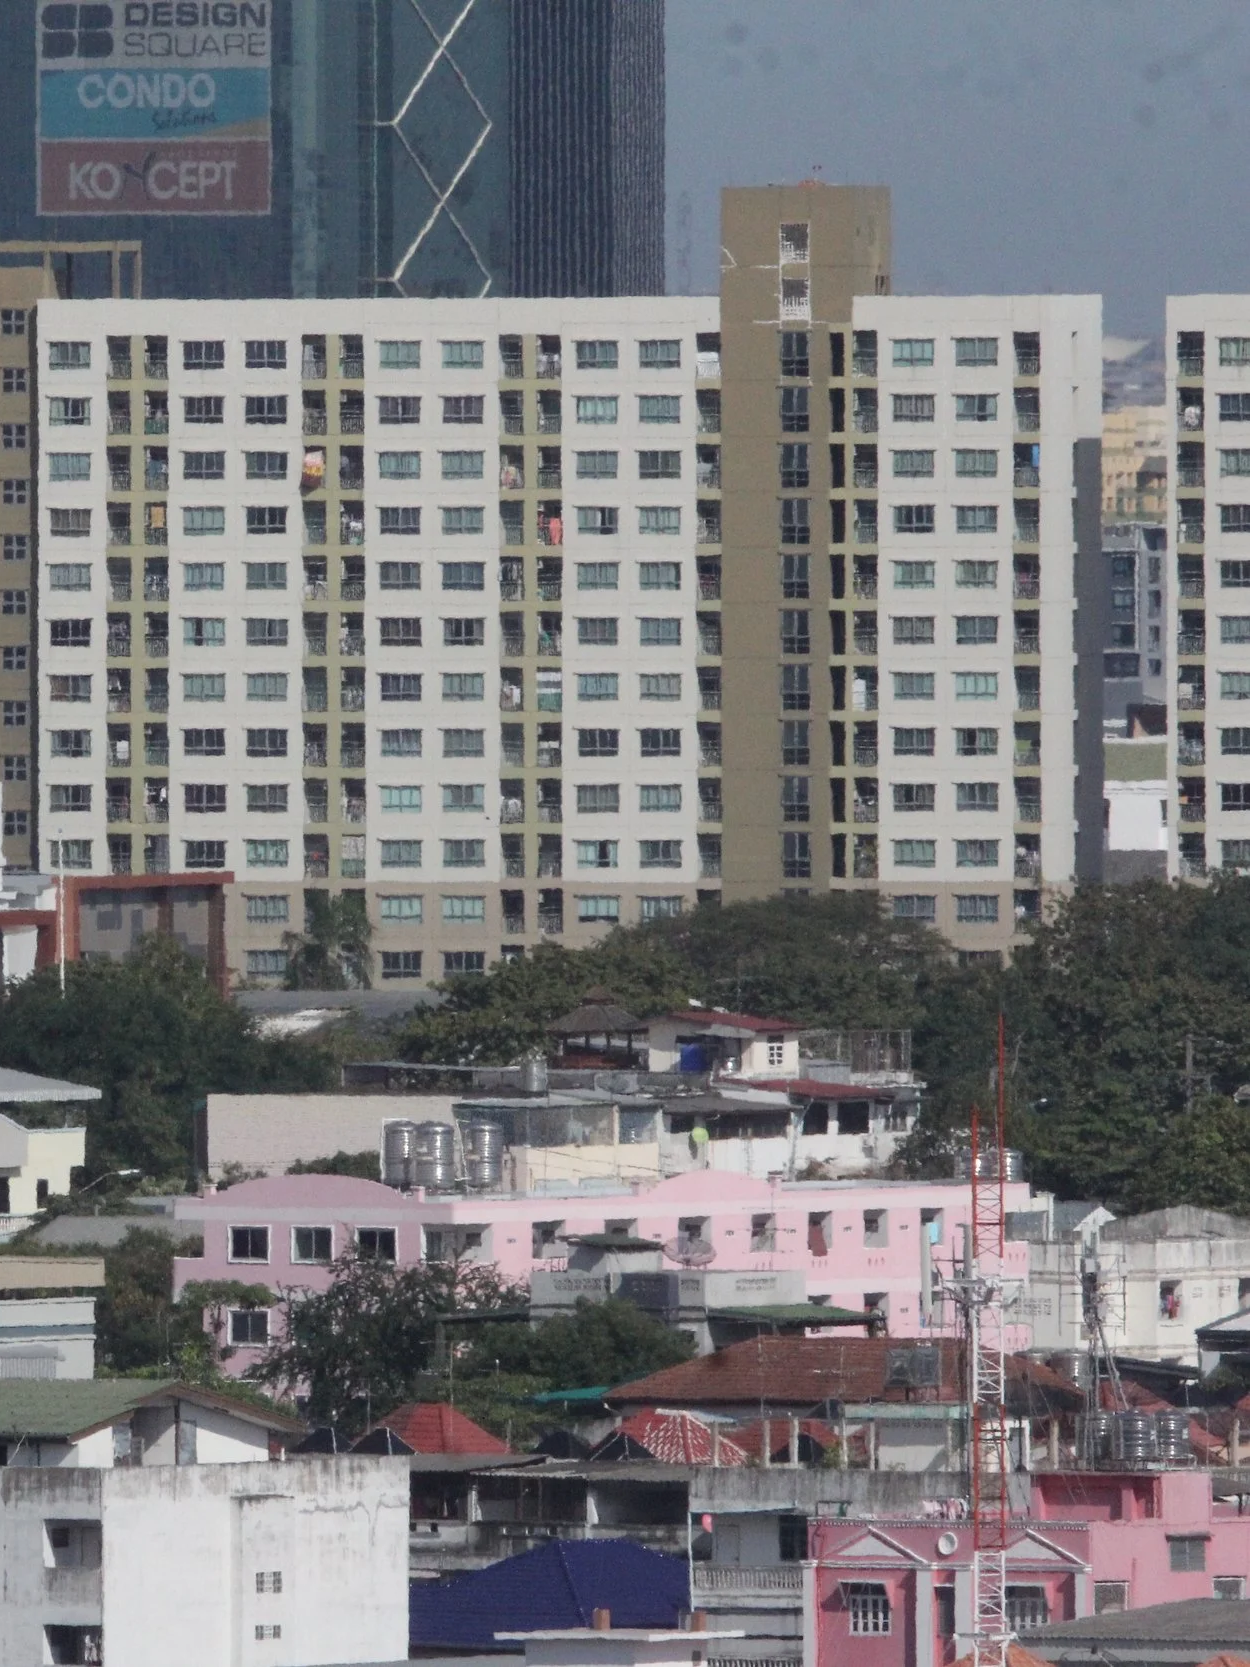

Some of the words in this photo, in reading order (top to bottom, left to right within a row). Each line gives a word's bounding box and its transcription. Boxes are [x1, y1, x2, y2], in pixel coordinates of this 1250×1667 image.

[124, 2, 266, 27] DESIGN
[124, 33, 266, 57] SQUARE
[77, 73, 216, 108] CONDO
